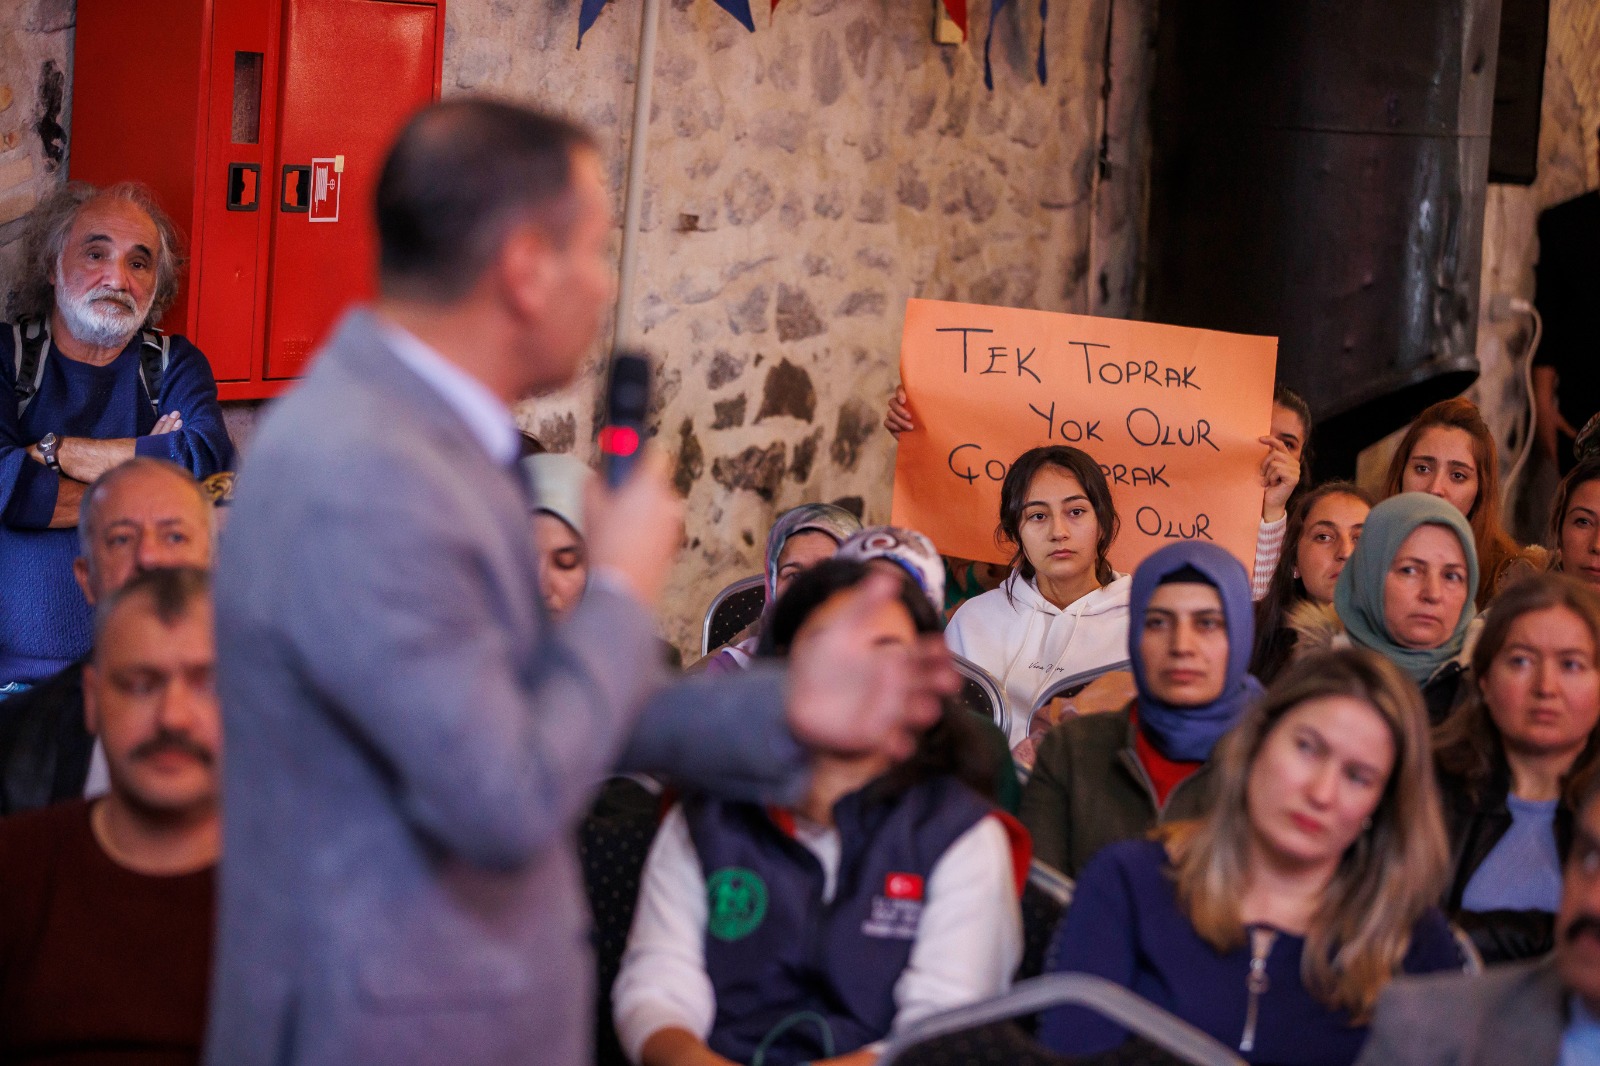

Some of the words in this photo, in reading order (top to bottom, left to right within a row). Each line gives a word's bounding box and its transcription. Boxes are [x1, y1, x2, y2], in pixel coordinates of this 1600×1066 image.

[935, 327, 1041, 384] TEK
[1068, 341, 1201, 390] TOPRAK
[1028, 401, 1104, 443] YOK
[1126, 407, 1220, 452] OLUR
[947, 443, 1013, 486] ÇO
[1097, 463, 1170, 488] PRAK
[1135, 506, 1213, 540] OLUR
